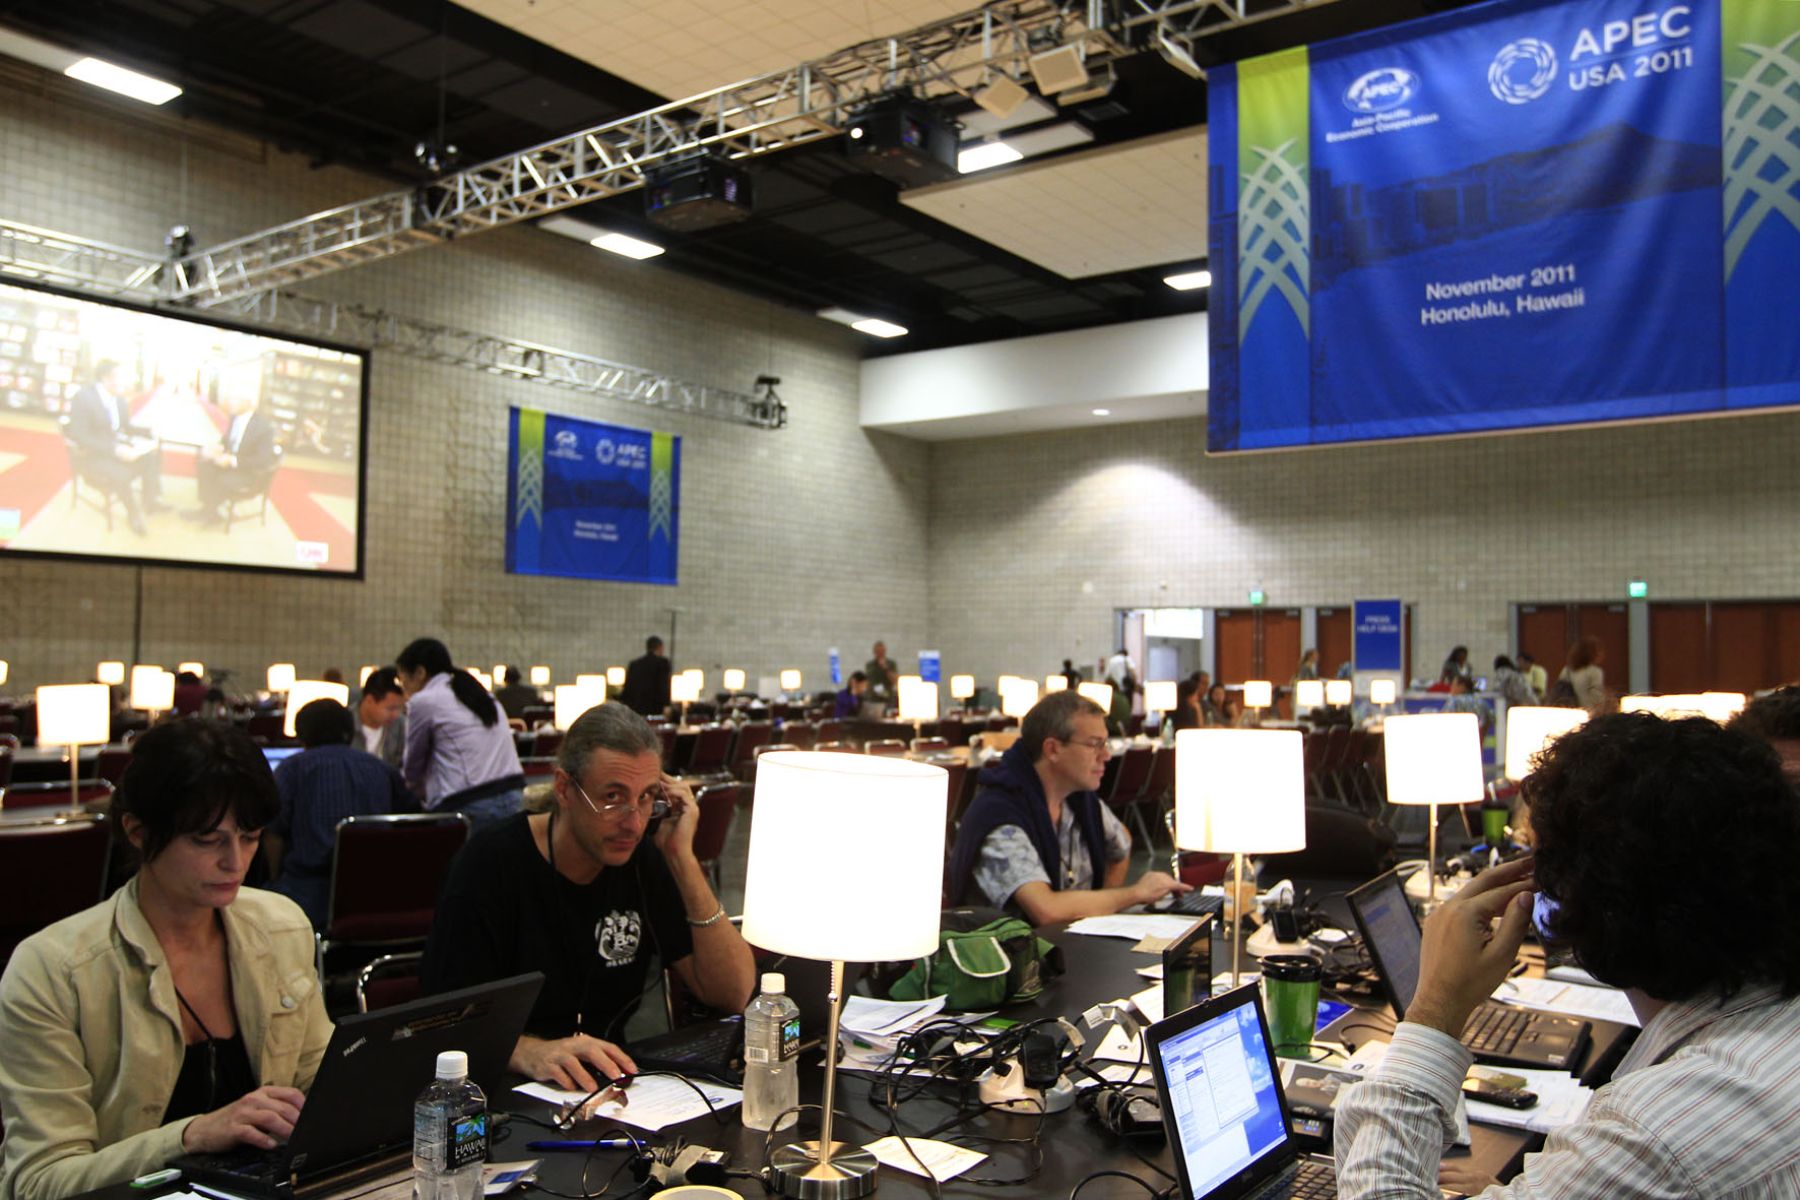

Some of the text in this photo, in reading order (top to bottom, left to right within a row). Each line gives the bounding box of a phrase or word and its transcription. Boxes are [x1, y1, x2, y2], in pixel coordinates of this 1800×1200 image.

[1569, 6, 1691, 61] APEC
[1568, 46, 1693, 91] USA 2011
[1425, 264, 1576, 301] November 2011
[1420, 287, 1586, 326] Honolulu, Hawaii
